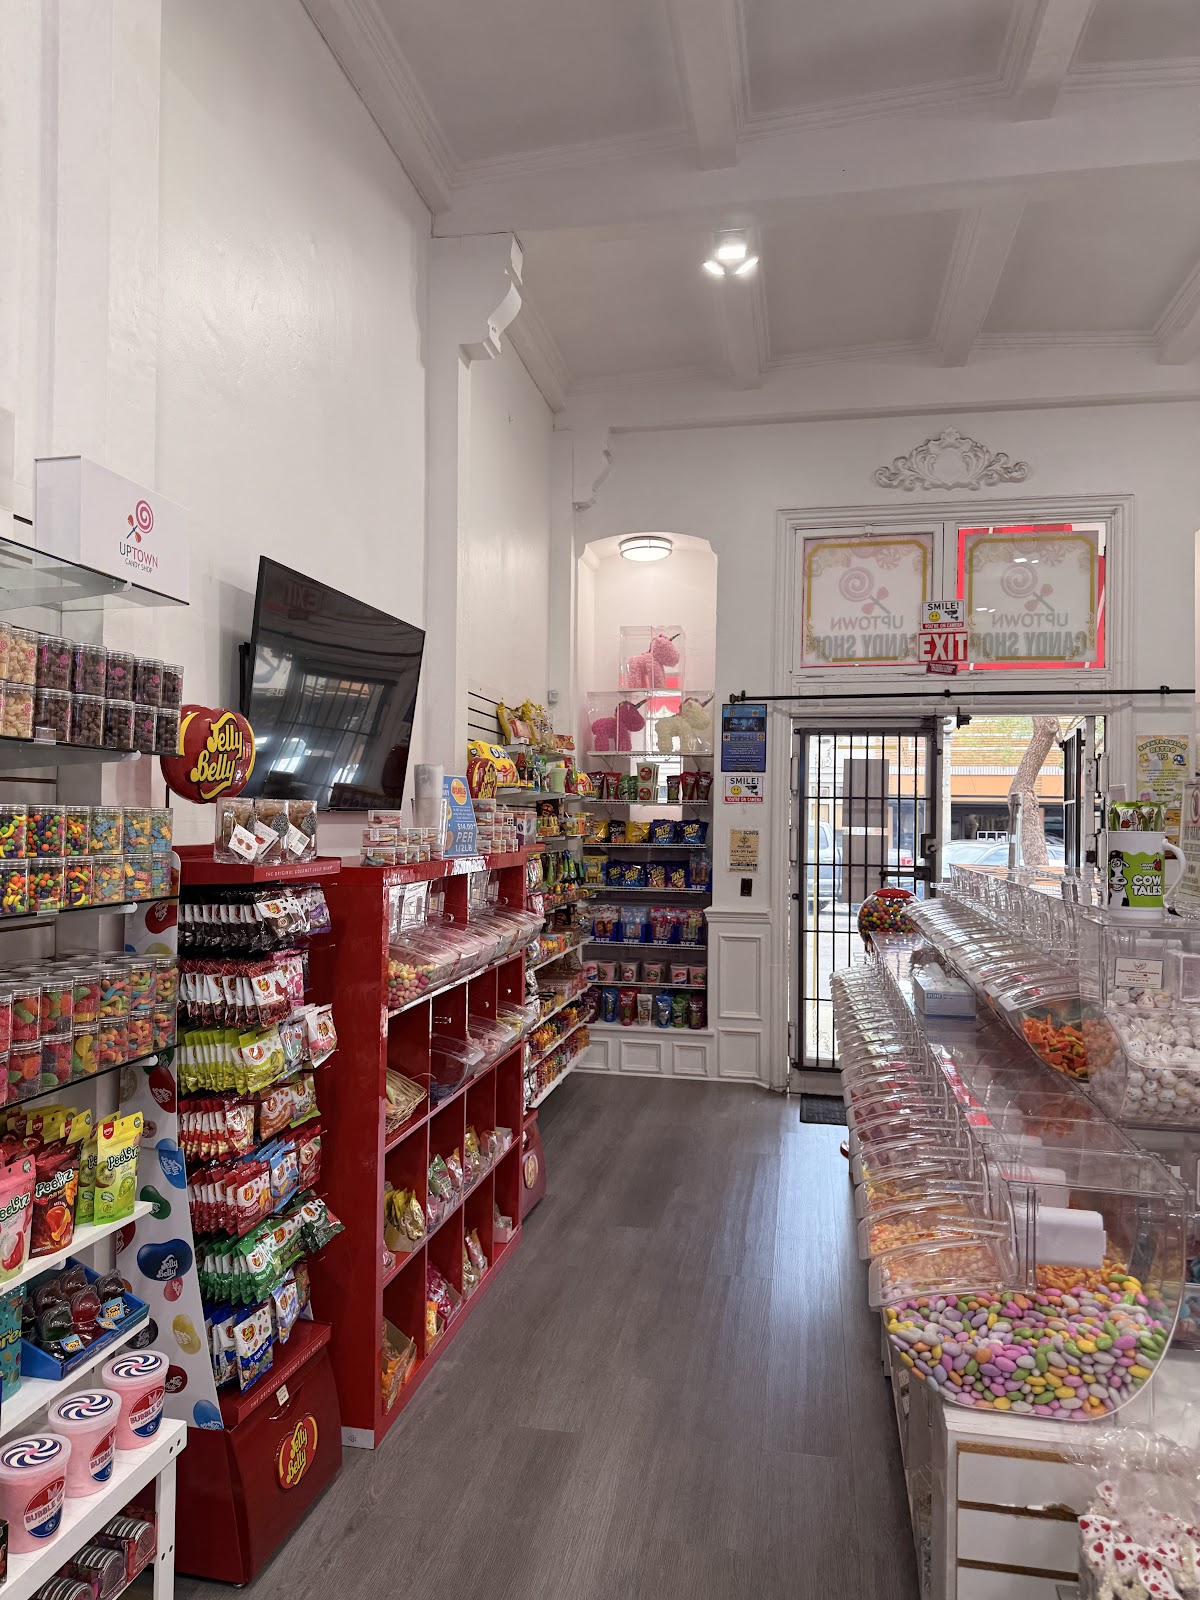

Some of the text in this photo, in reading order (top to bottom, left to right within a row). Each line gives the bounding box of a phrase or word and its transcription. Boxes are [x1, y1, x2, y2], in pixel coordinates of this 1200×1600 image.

[120, 542, 158, 568] UPTOWN
[125, 558, 153, 574] CANDY SHOP
[928, 602, 959, 610] SMILE!
[920, 633, 967, 662] EXIT
[207, 711, 244, 760] Jelly
[1150, 746, 1176, 754] RETRO
[190, 749, 237, 800] Belly
[452, 786, 466, 795] BUBS
[655, 824, 670, 838] Takis
[683, 823, 699, 836] Takis
[456, 832, 474, 843] PER
[625, 869, 638, 880] Takis
[670, 869, 685, 881] Takis
[1132, 874, 1162, 886] COW
[1131, 885, 1162, 896] TALES
[0, 1192, 30, 1222] eelerz
[162, 1254, 178, 1270] Jelly
[156, 1266, 176, 1280] Belly
[253, 1350, 262, 1360] KIDS
[260, 1380, 280, 1399] ORIGINAL
[281, 1362, 300, 1380] GOURMET
[130, 1406, 156, 1424] BUBBLE
[290, 1421, 308, 1459] Jelly
[286, 1448, 306, 1485] Belly
[25, 1500, 56, 1524] BUBBLE
